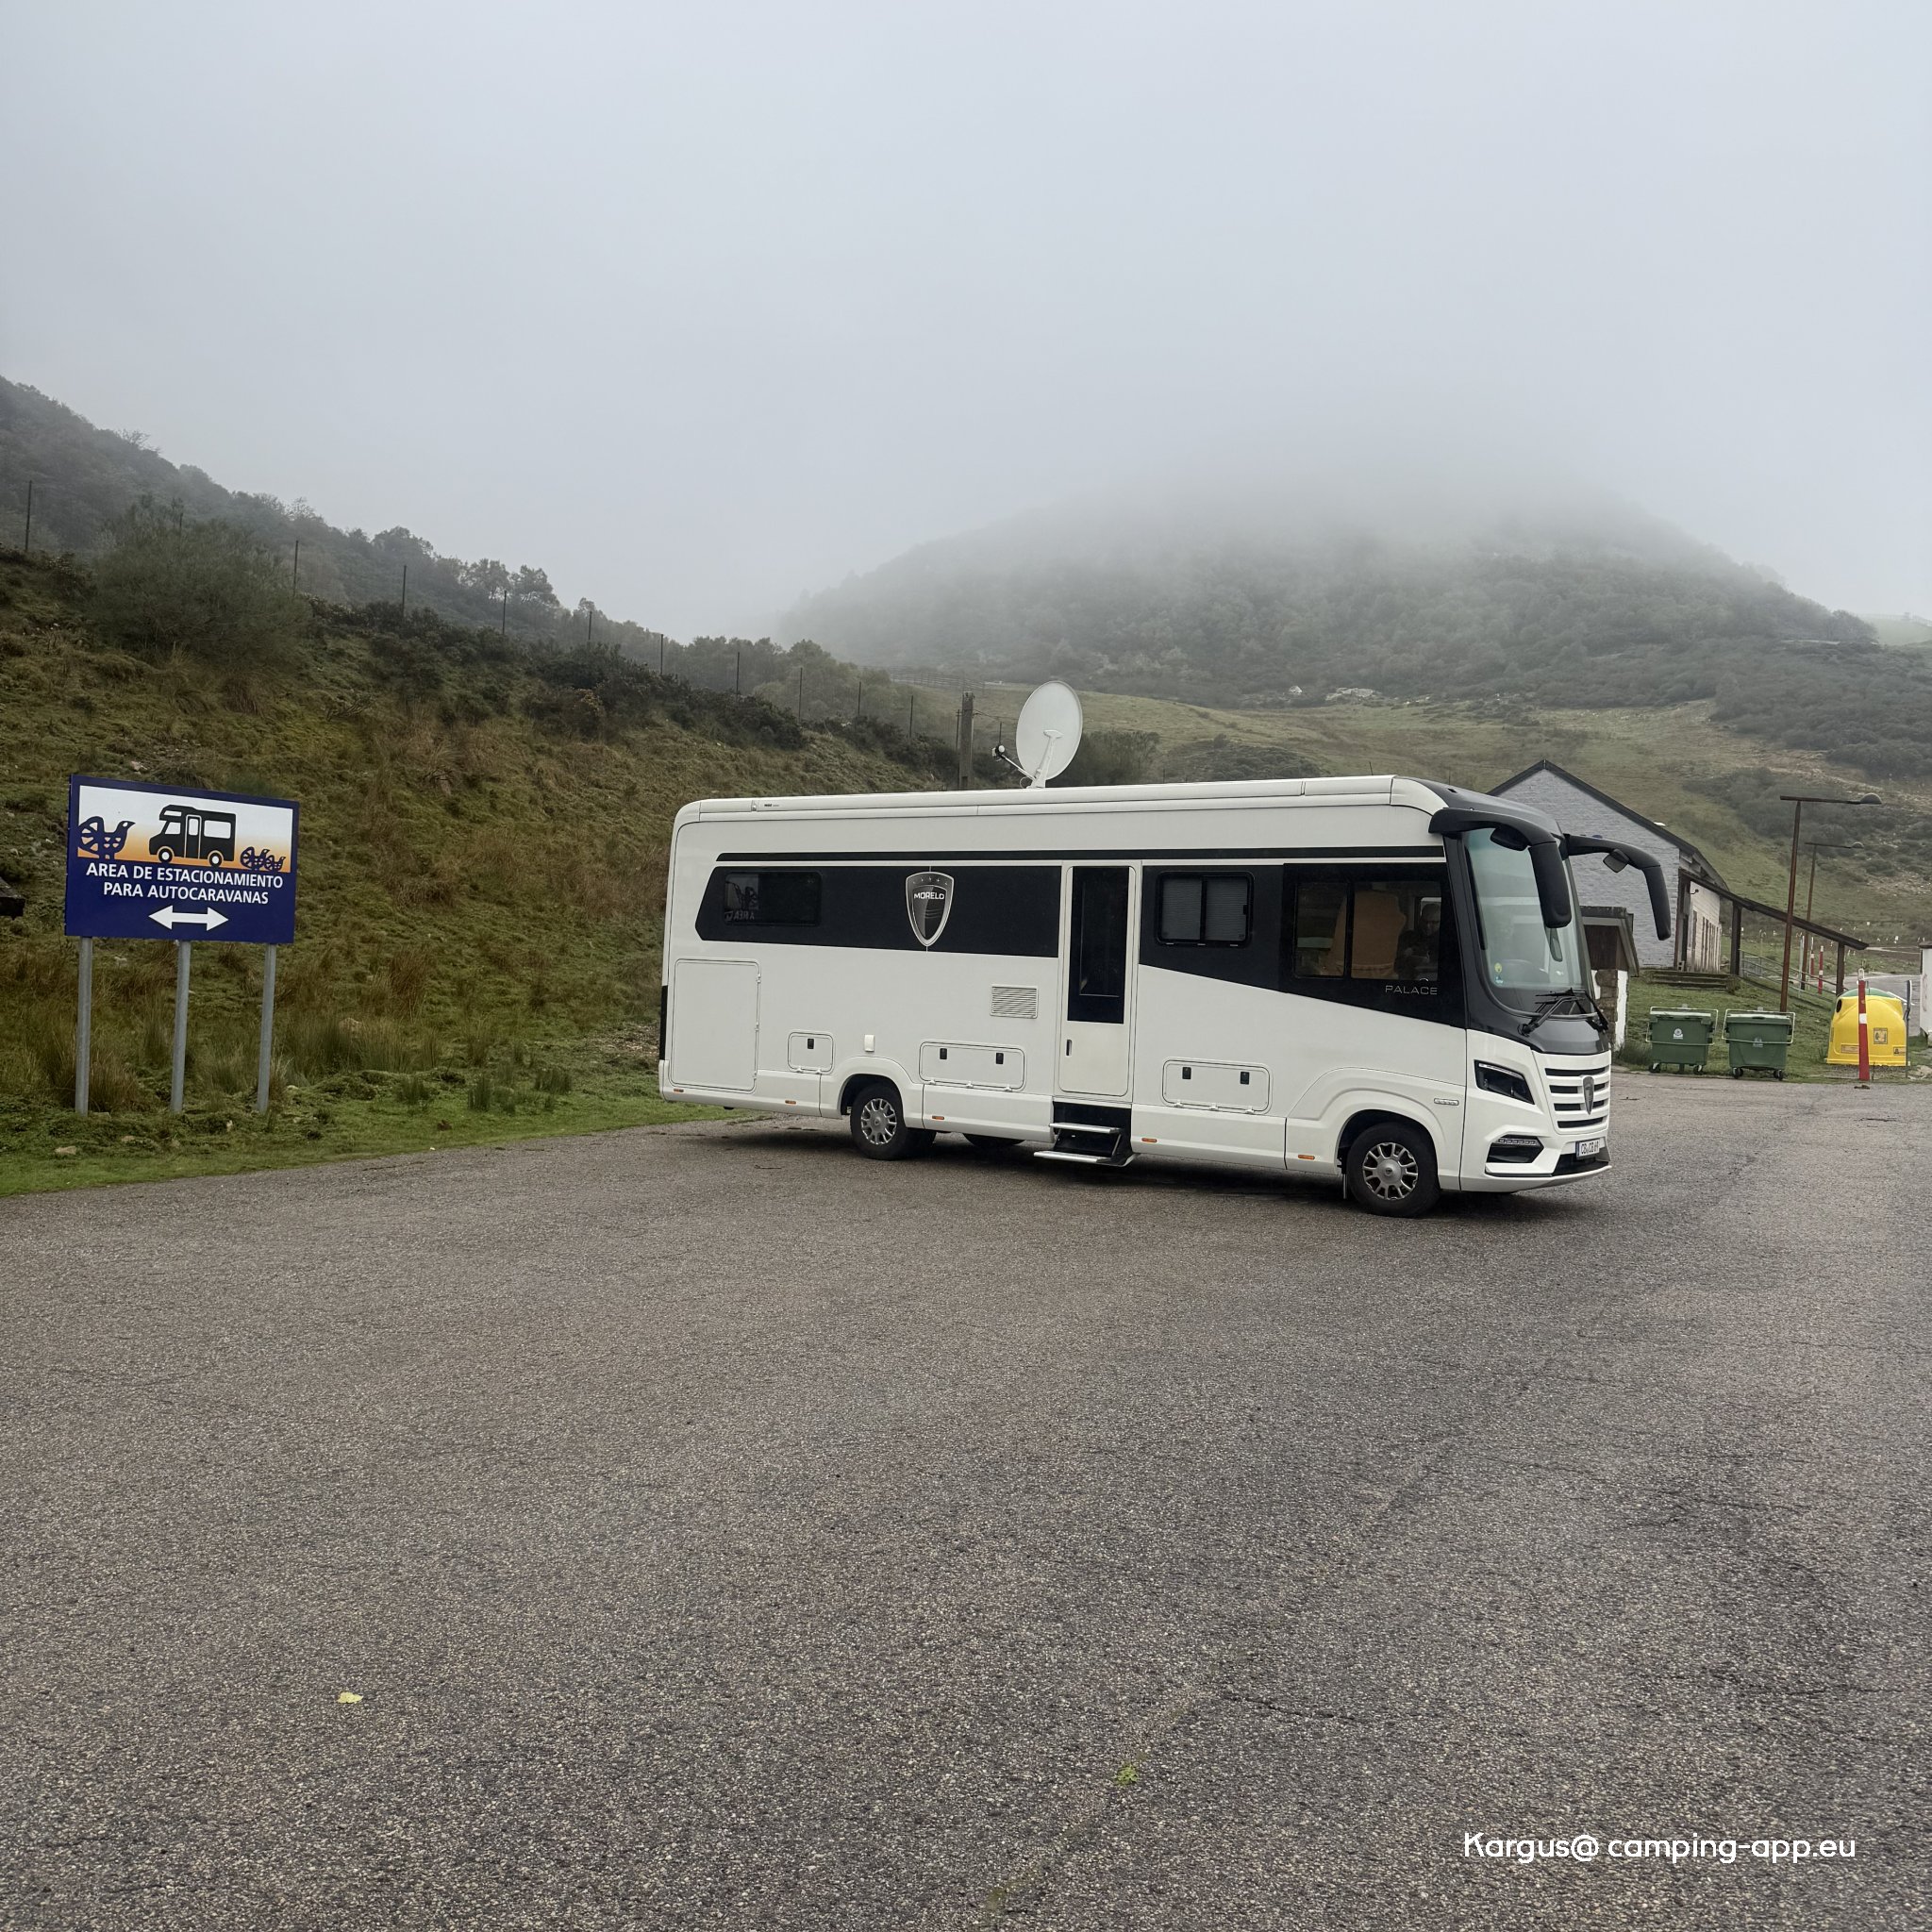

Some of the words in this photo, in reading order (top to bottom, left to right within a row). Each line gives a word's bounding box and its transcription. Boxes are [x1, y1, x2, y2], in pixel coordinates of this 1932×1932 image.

[86, 862, 129, 878] AREA
[133, 865, 152, 880] DE
[157, 867, 284, 889] ESTACIONAMIENTO
[103, 881, 143, 898] PARA
[147, 885, 269, 905] AUTOCARAVANAS
[1385, 985, 1438, 995] PALACE
